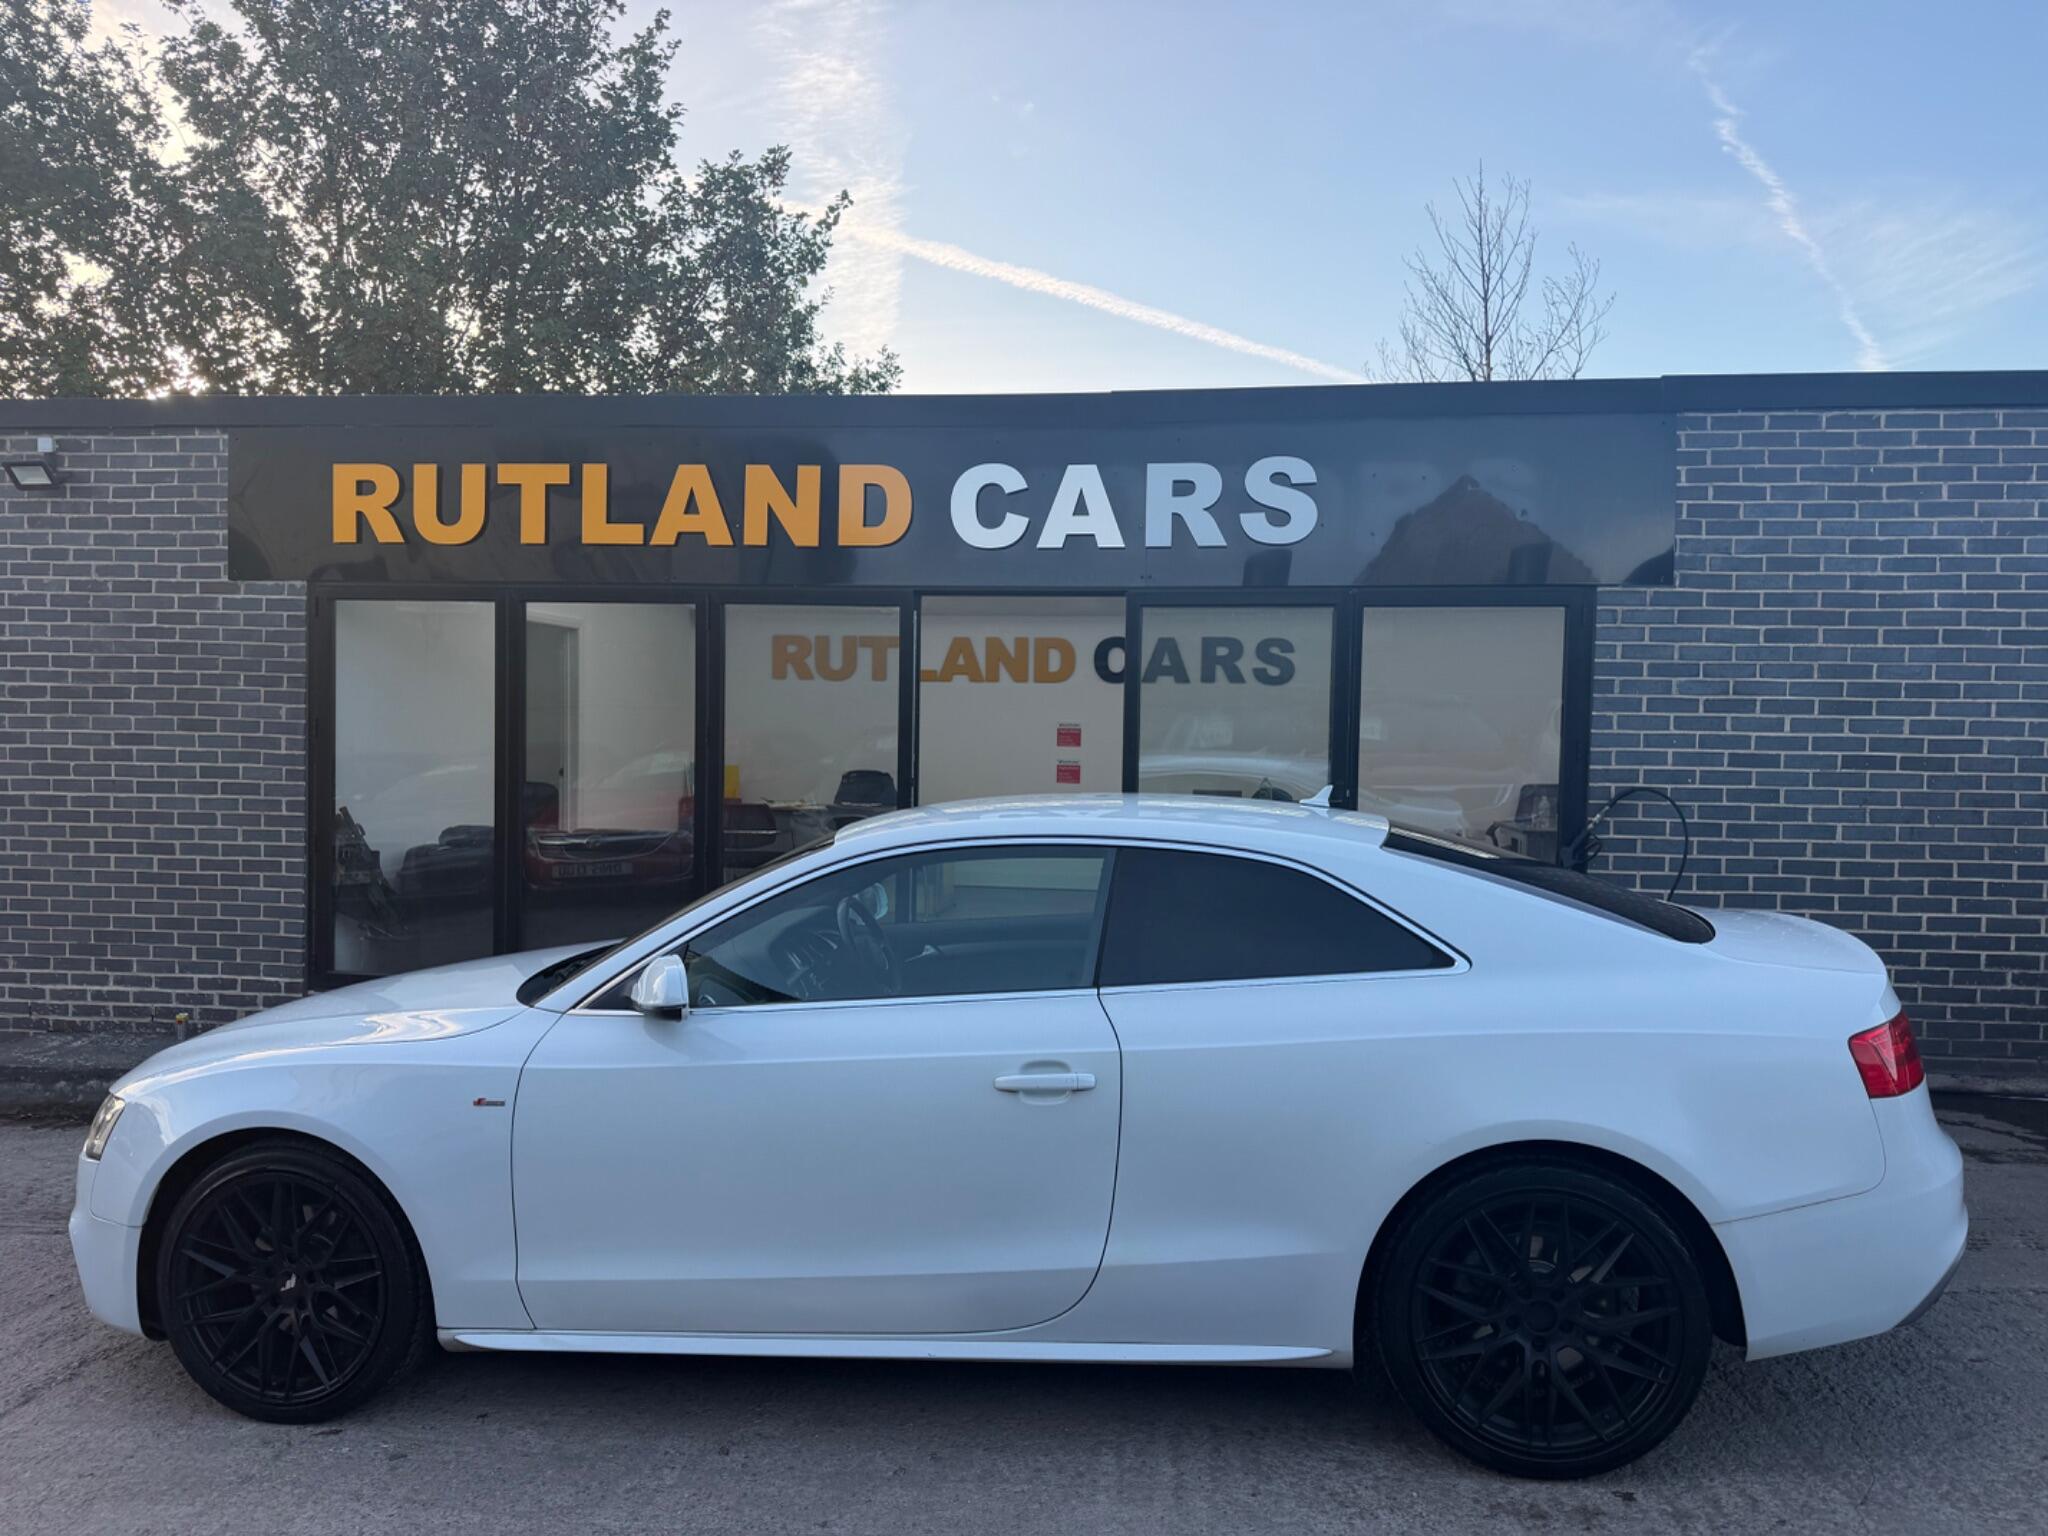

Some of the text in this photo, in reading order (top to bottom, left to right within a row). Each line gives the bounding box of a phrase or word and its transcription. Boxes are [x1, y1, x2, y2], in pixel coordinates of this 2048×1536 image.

[332, 456, 1318, 549] RUTLAND CARS
[1094, 636, 1296, 686] CARS
